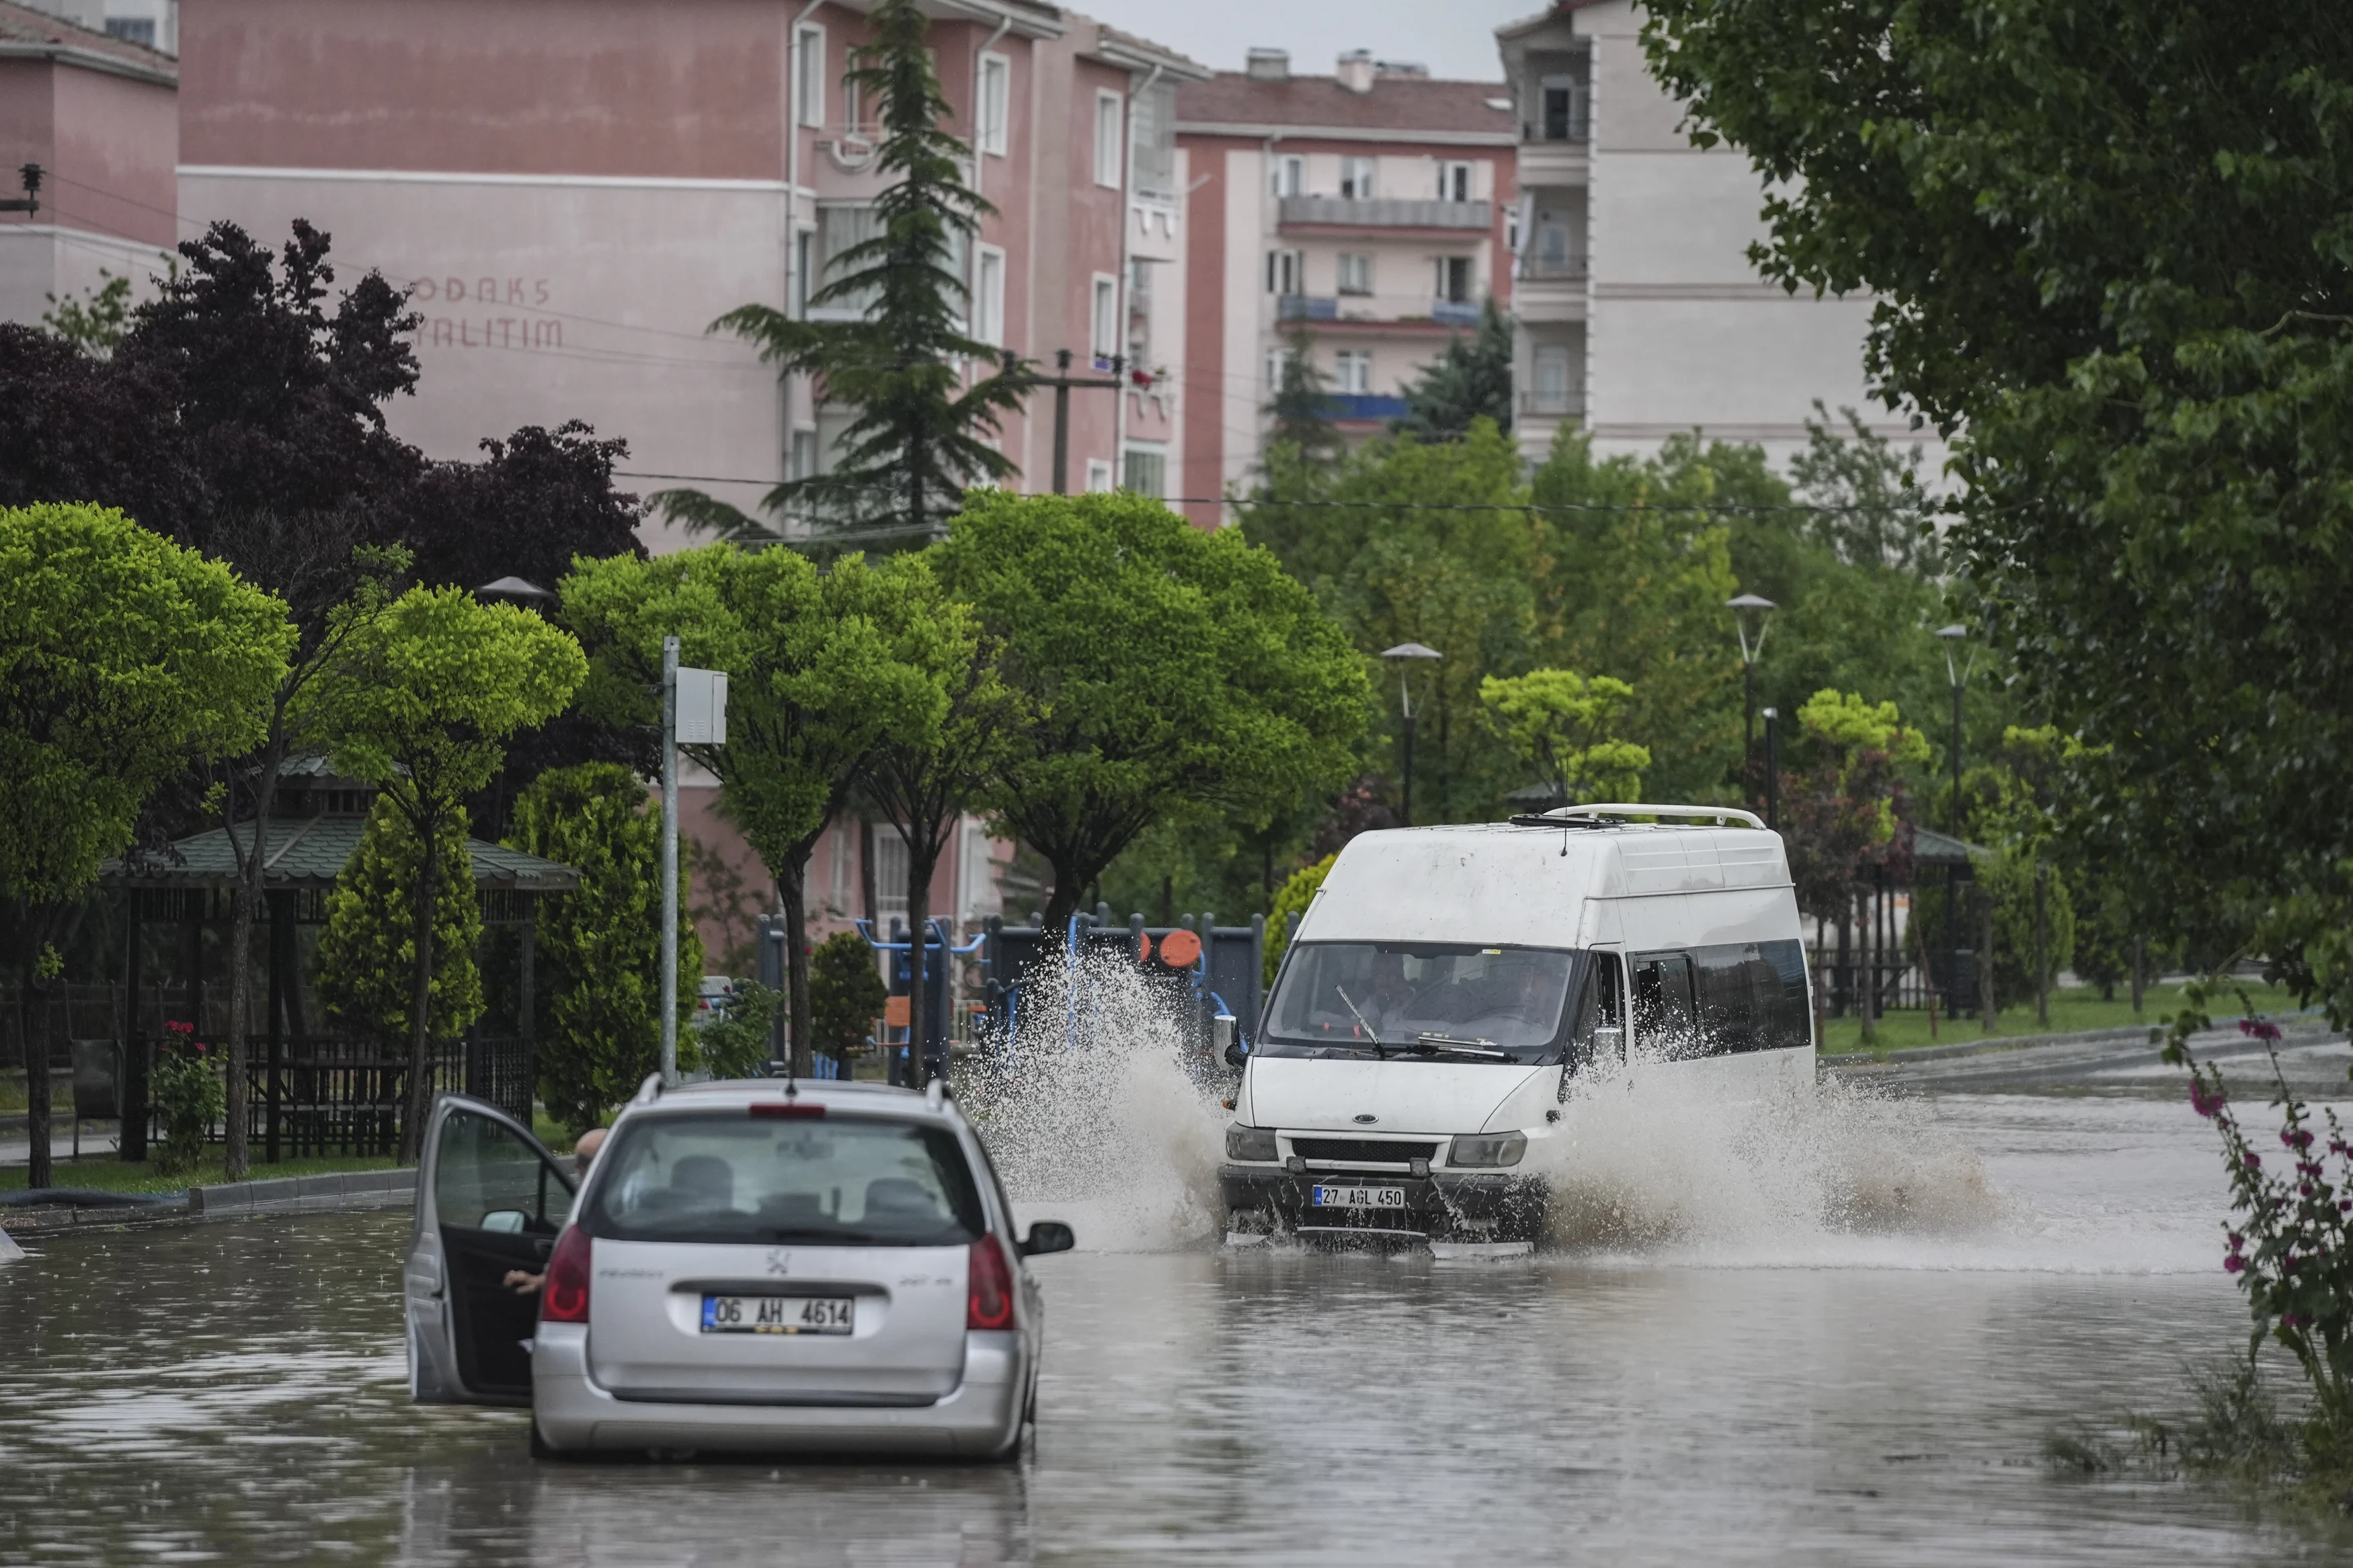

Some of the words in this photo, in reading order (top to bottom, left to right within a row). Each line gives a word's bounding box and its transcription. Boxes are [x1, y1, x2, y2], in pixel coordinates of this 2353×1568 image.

[1323, 1189, 1339, 1204] 27
[1349, 1190, 1371, 1205] AGL
[1378, 1190, 1401, 1205] 450
[717, 1298, 742, 1322] 06
[757, 1298, 783, 1323] AH
[800, 1300, 848, 1324] 4614
